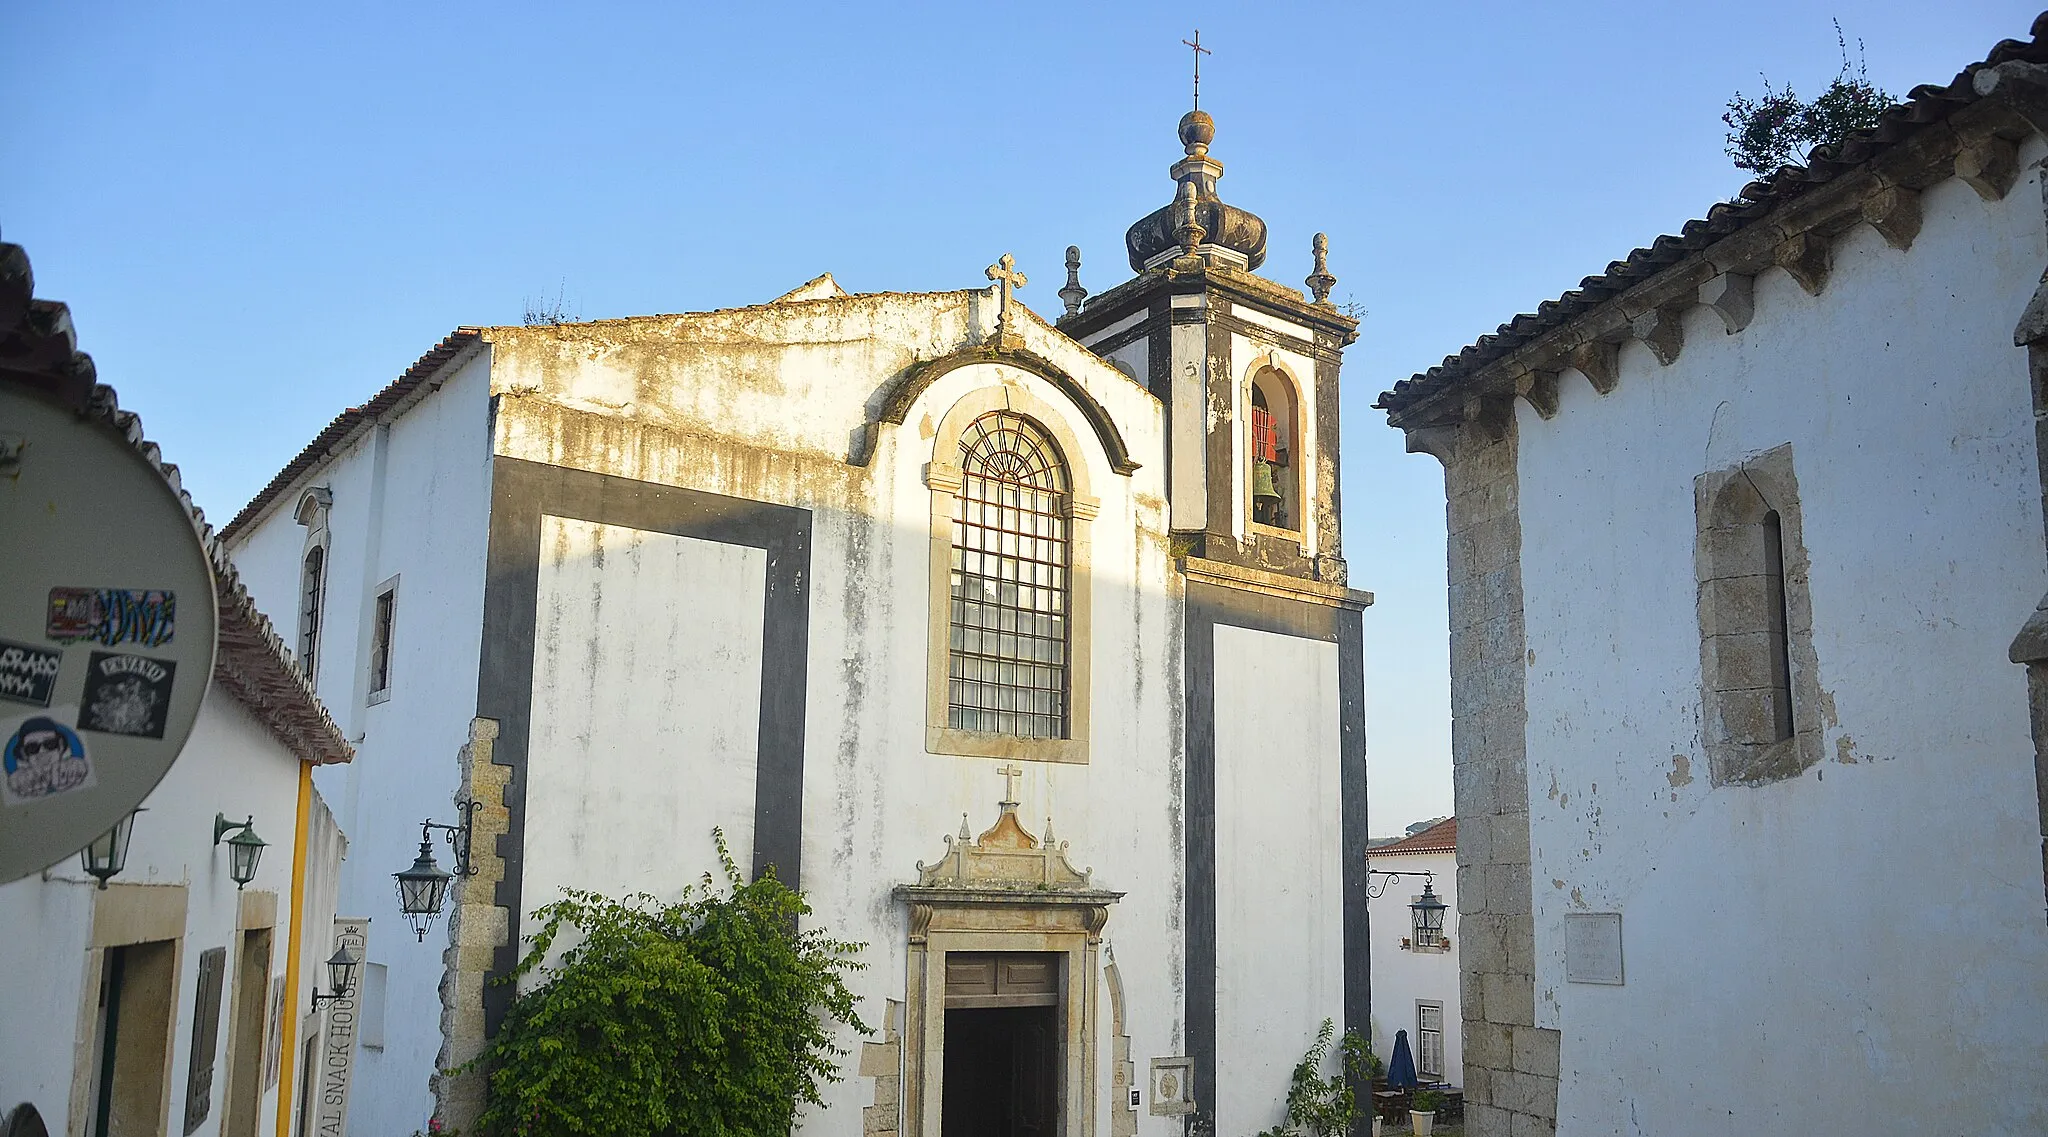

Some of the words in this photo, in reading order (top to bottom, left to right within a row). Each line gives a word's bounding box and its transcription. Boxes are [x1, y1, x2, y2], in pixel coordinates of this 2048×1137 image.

[342, 938, 359, 946] REAL
[324, 1043, 350, 1106] SNACK
[319, 1110, 342, 1137] AL
